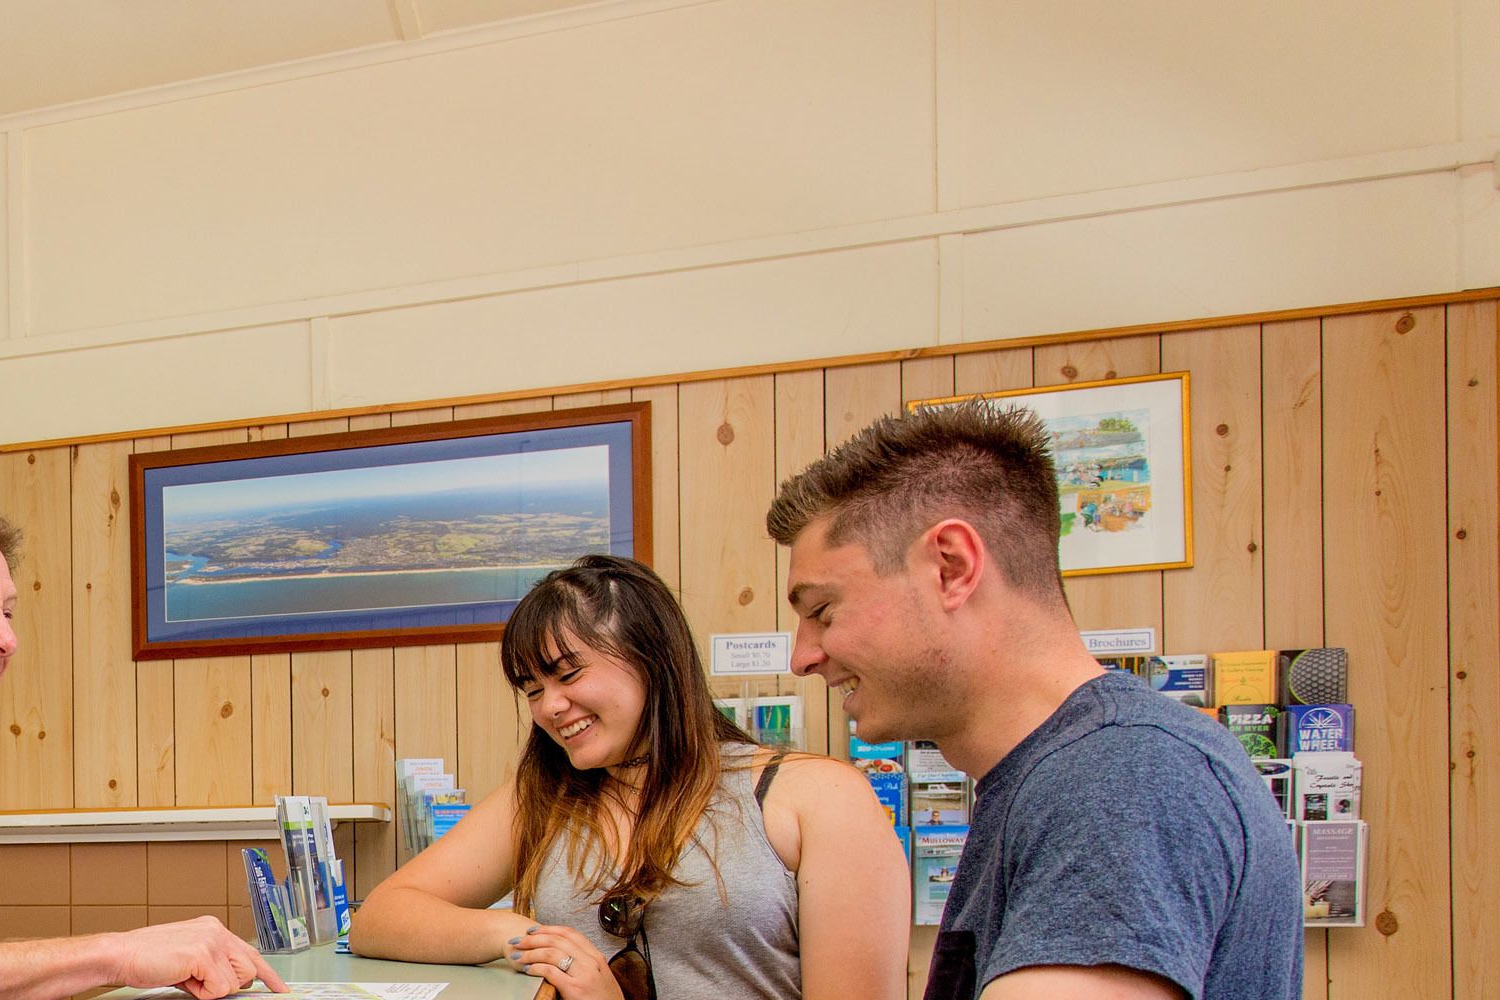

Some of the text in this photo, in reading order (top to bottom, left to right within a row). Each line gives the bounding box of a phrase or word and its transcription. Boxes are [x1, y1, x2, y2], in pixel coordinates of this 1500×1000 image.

[726, 640, 776, 649] Postcards
[1089, 638, 1147, 648] Brochures
[1228, 713, 1273, 725] PIZZA
[1300, 728, 1343, 740] WATER
[1300, 740, 1342, 751] WHEEL
